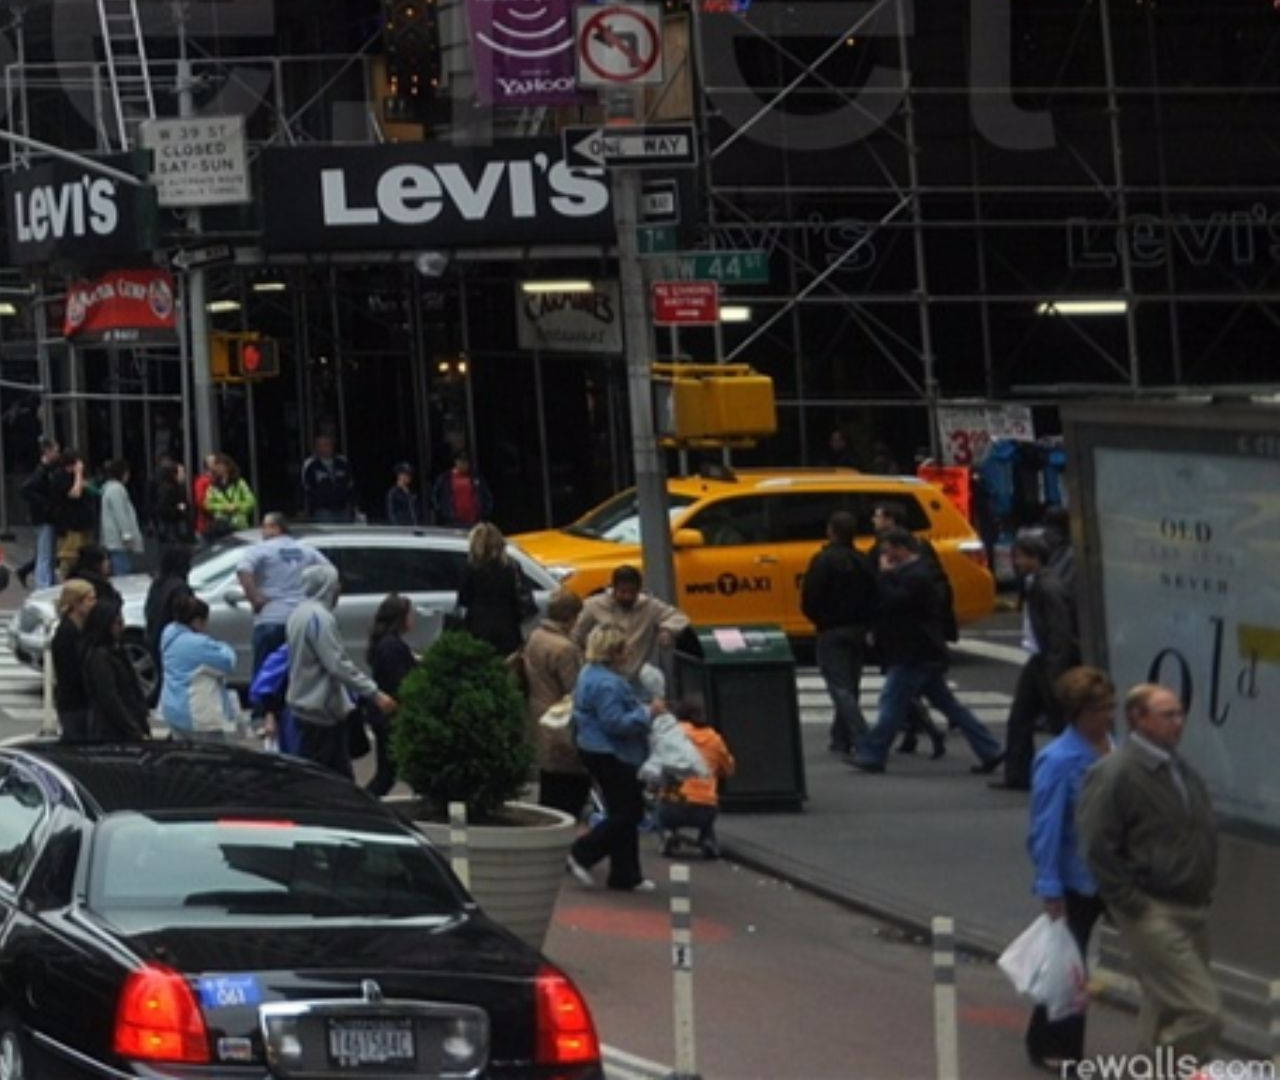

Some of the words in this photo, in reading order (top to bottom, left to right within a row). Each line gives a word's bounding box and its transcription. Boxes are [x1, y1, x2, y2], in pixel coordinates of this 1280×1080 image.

[163, 142, 226, 158] CLOSED
[643, 137, 681, 154] WAY
[708, 257, 741, 277] 44
